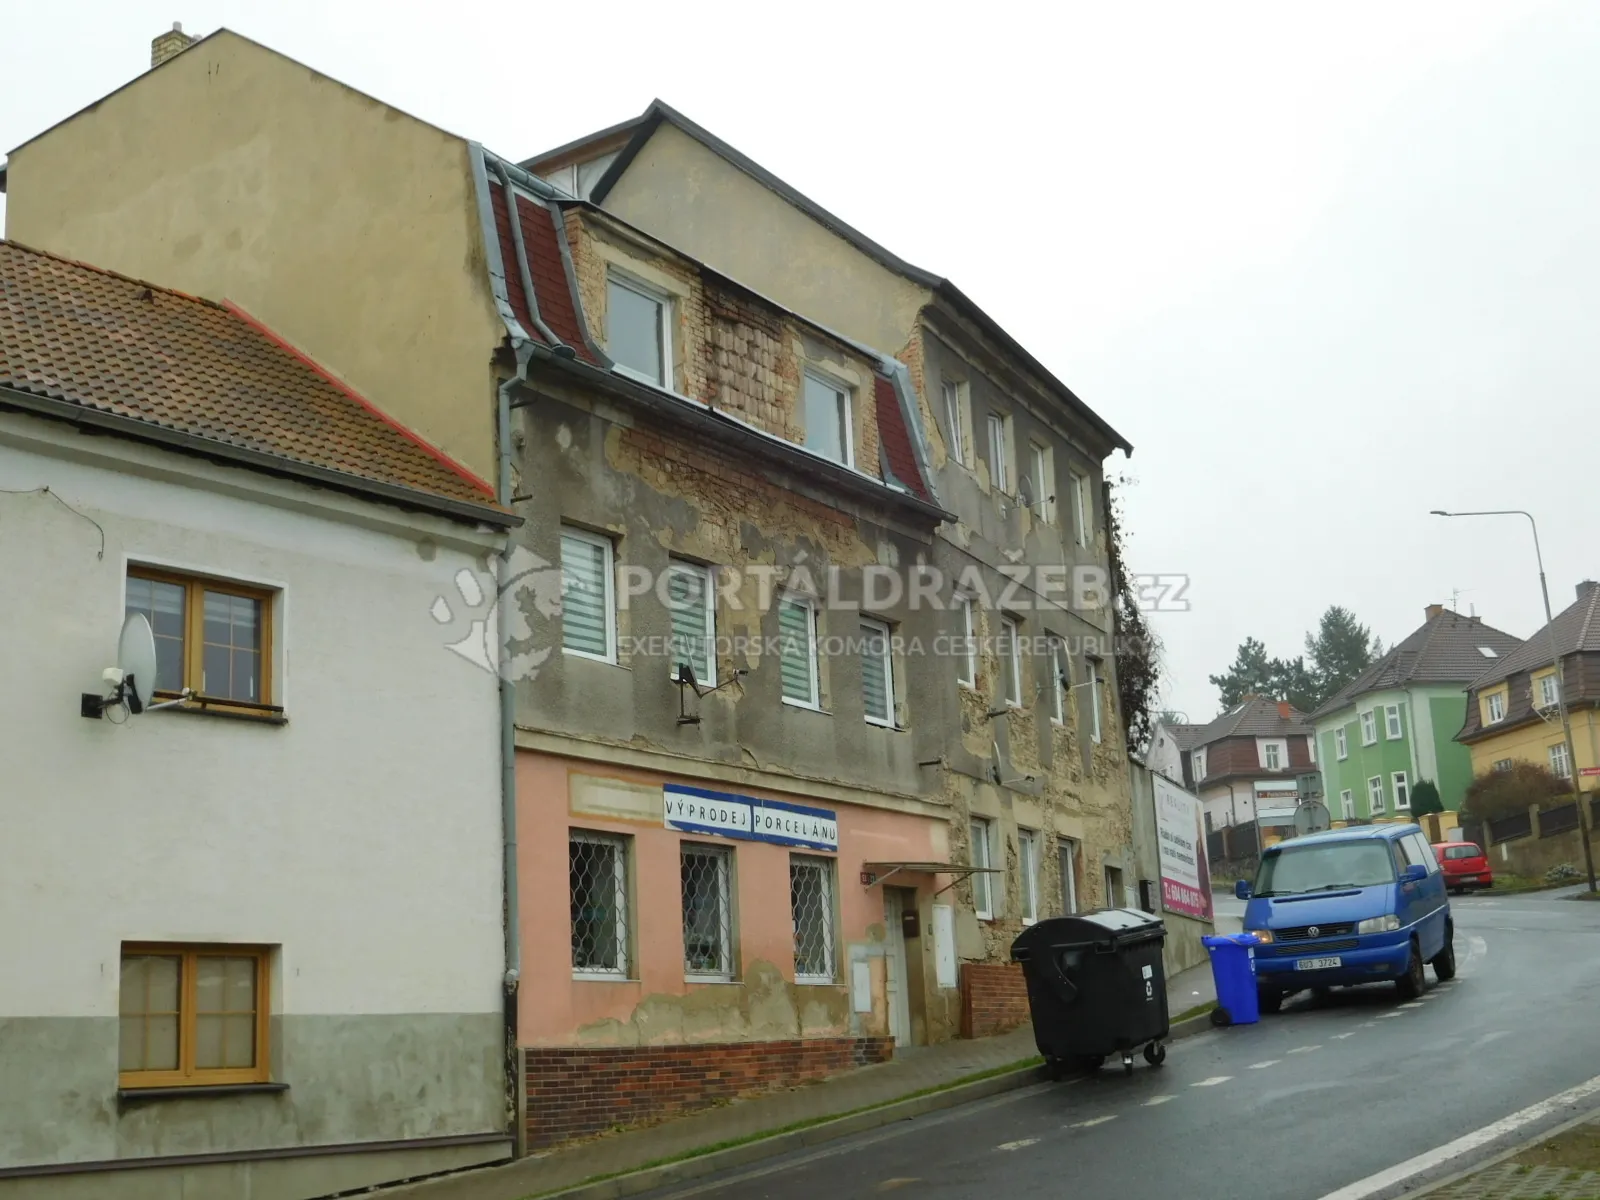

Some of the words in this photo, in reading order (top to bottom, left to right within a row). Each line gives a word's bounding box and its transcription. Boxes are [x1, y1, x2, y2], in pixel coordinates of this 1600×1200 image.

[665, 799, 747, 825] VÝPRODEJ
[755, 815, 836, 841] PORCELÁNU
[1319, 958, 1337, 968] 3724
